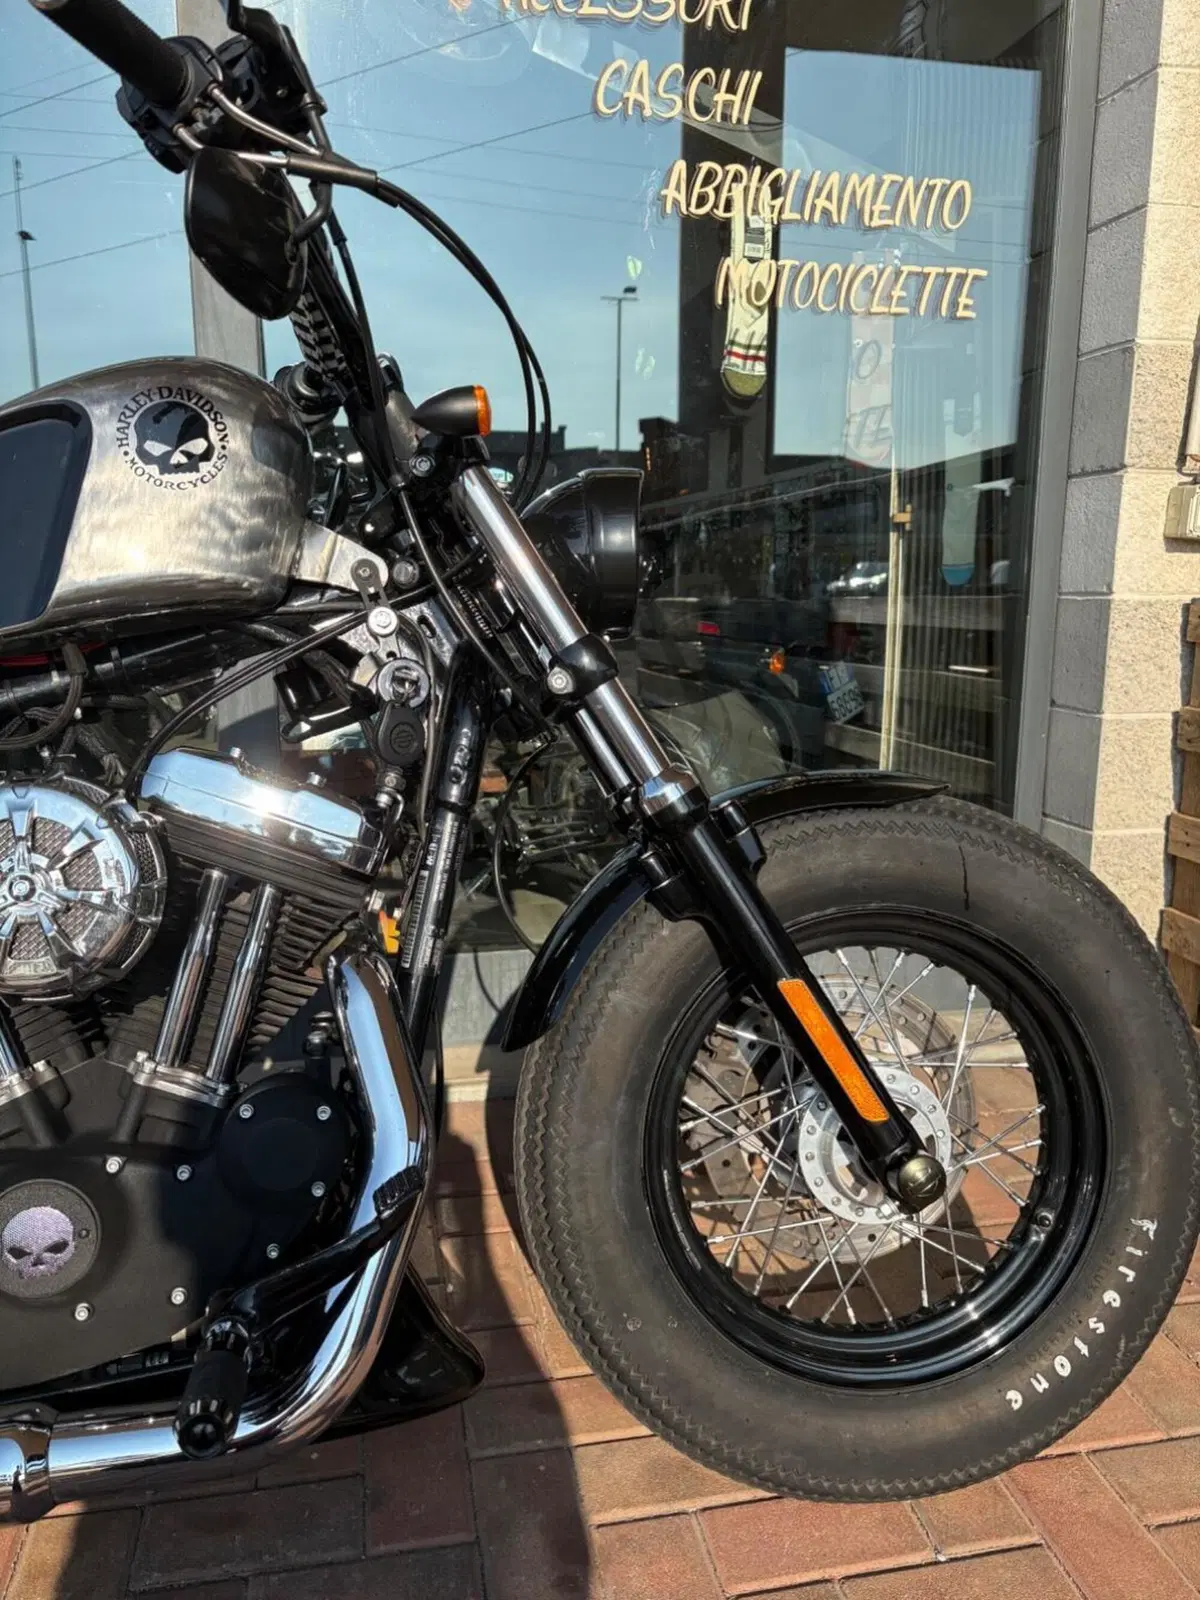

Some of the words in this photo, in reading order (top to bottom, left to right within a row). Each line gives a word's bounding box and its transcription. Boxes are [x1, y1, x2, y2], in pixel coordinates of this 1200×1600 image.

[594, 58, 763, 125] CASCHI
[660, 159, 972, 230] ABBIGLIAMENTO
[715, 256, 989, 319] MOTOCICLETTE
[124, 454, 228, 491] MOTORCYCLES
